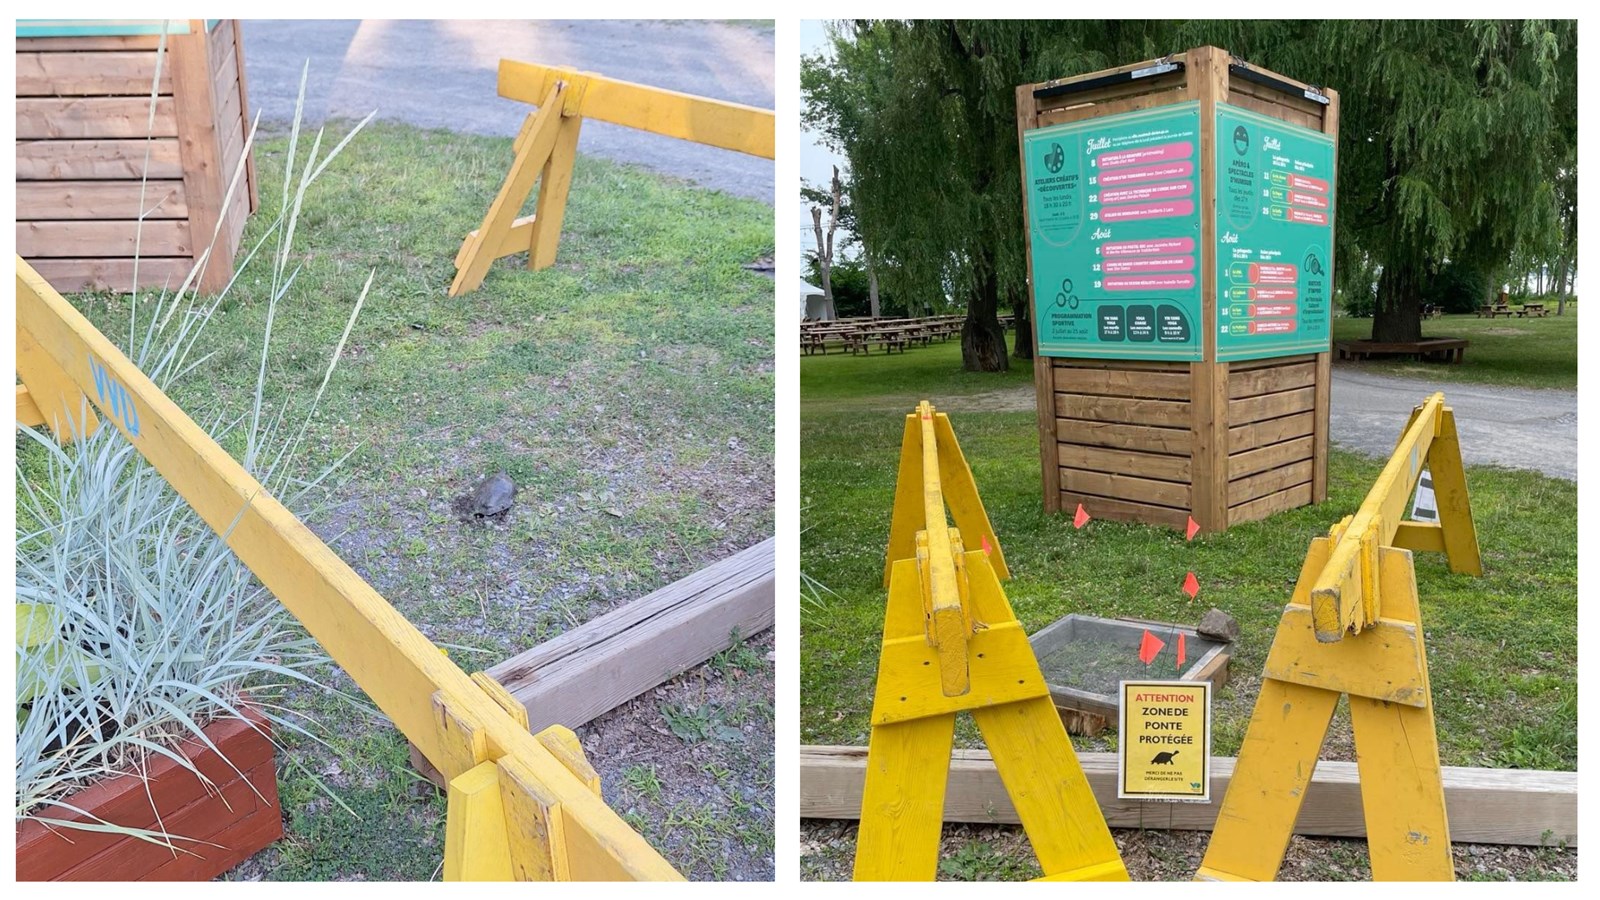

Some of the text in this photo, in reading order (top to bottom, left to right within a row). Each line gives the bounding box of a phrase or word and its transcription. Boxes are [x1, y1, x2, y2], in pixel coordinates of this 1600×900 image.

[1087, 137, 1111, 154] Juillet
[1091, 228, 1111, 240] Août
[1136, 694, 1194, 703] ATTENTION
[1142, 707, 1174, 716] ZONE
[1145, 722, 1182, 730] PONTE
[1140, 734, 1192, 744] PROTÉGÉE
